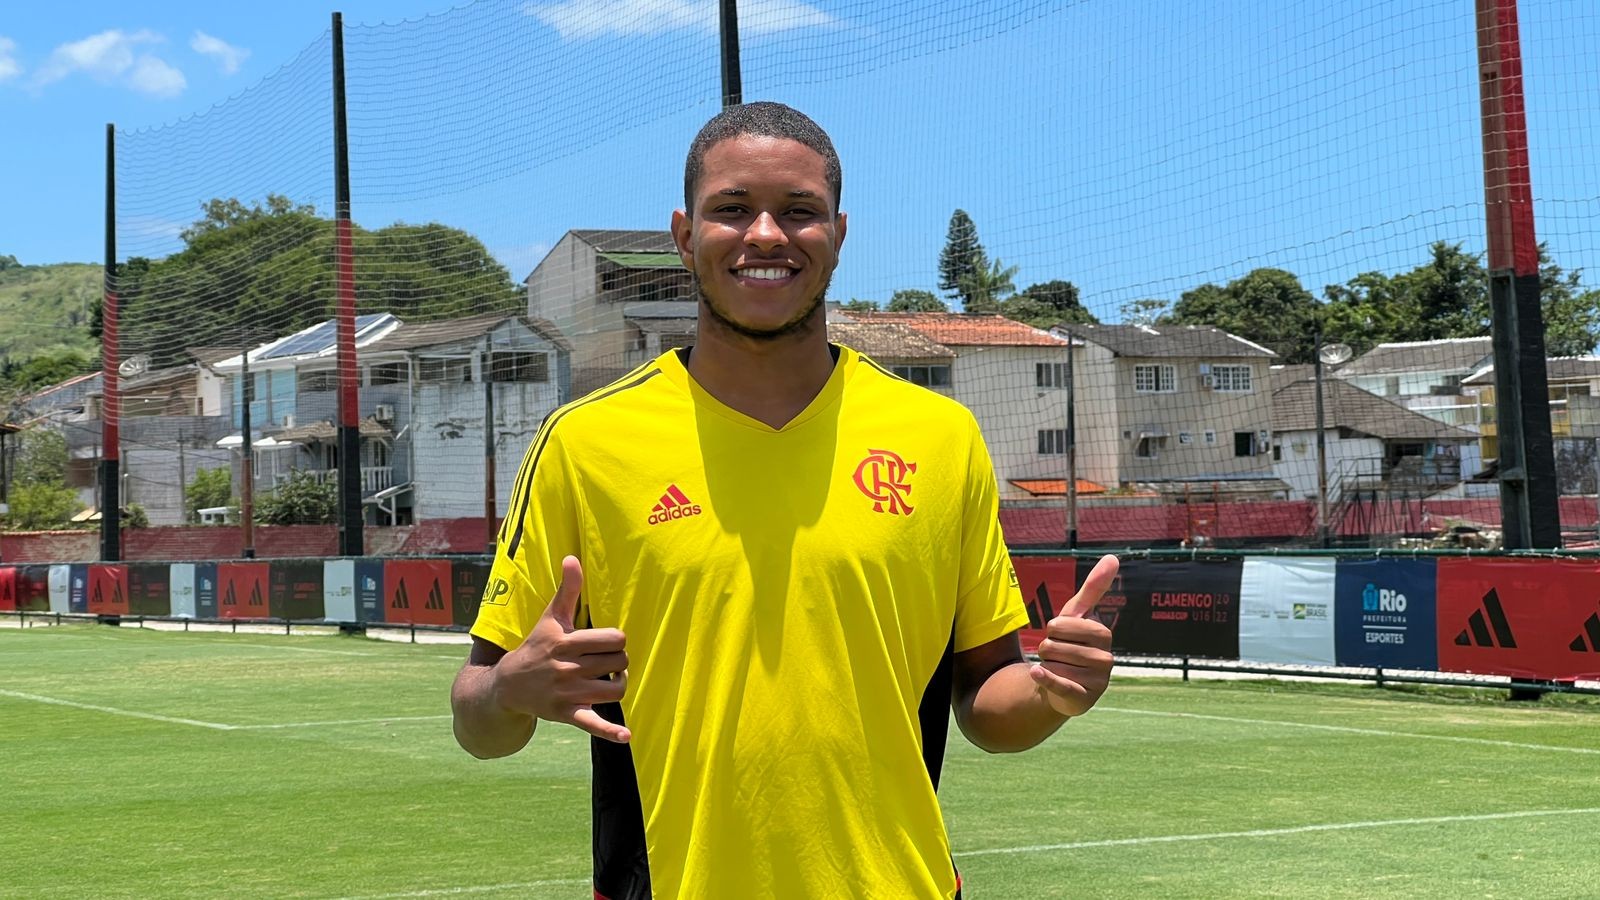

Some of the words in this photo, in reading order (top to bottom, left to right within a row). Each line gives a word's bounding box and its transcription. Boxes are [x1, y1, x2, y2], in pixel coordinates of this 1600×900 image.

[648, 503, 702, 525] adidas
[1151, 592, 1212, 608] FLAMENGO
[1379, 588, 1407, 612] Rio
[1192, 611, 1210, 622] U16
[1216, 611, 1228, 622] 22
[1363, 614, 1407, 623] PREFEITURA
[1365, 632, 1405, 644] ESPORTES
